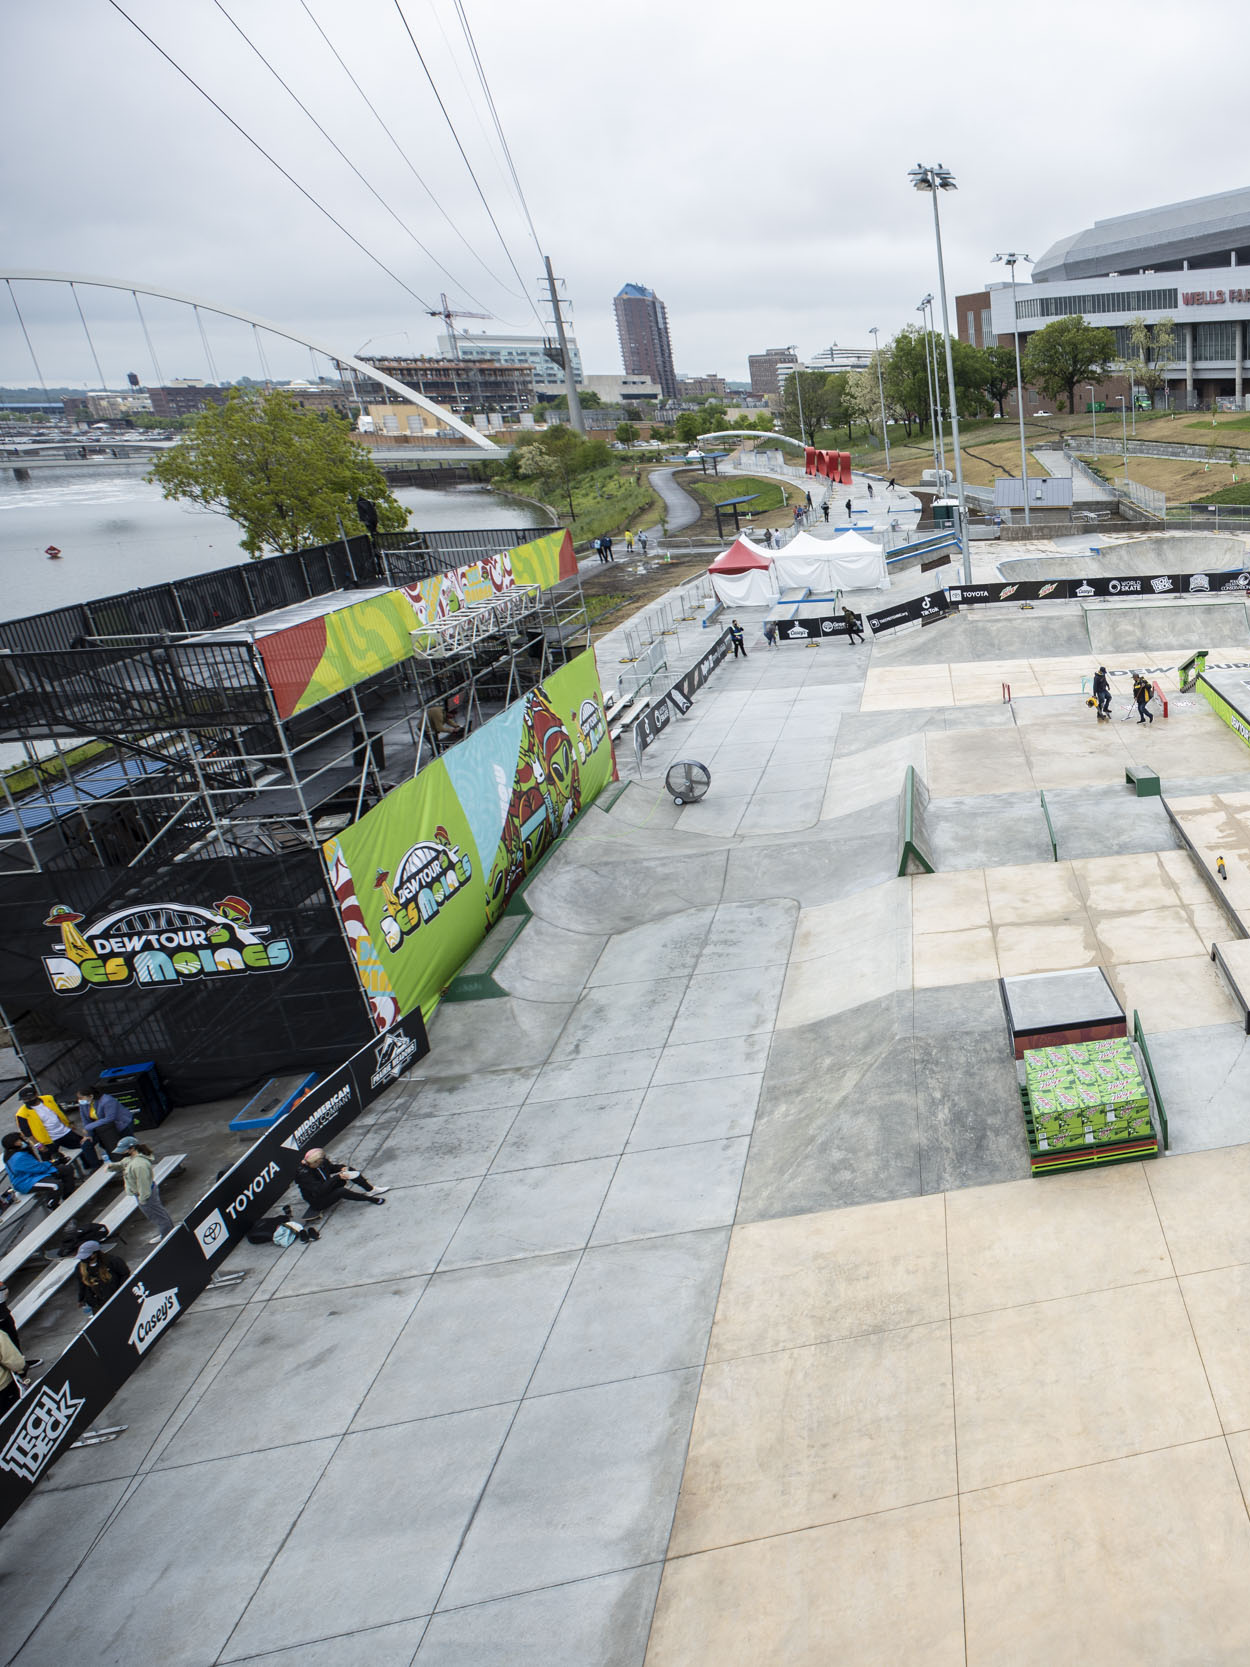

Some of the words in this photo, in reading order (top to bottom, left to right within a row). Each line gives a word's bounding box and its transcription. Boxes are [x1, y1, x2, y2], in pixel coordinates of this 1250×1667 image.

[1182, 290, 1225, 305] WELLS
[920, 606, 939, 616] TikTok
[398, 860, 443, 904] DEWTOUR
[94, 929, 208, 955] DEWTOUR
[373, 1061, 392, 1086] PRAIRIE
[392, 1042, 416, 1068] MEADOWS
[293, 1084, 351, 1139] MIDAMERICAN
[297, 1121, 320, 1146] ENERGY
[319, 1090, 352, 1122] COMPANY
[226, 1160, 280, 1220] TOYOTA
[136, 1295, 175, 1344] Casey's
[5, 1394, 58, 1465] TECH
[26, 1397, 80, 1473] DECK
